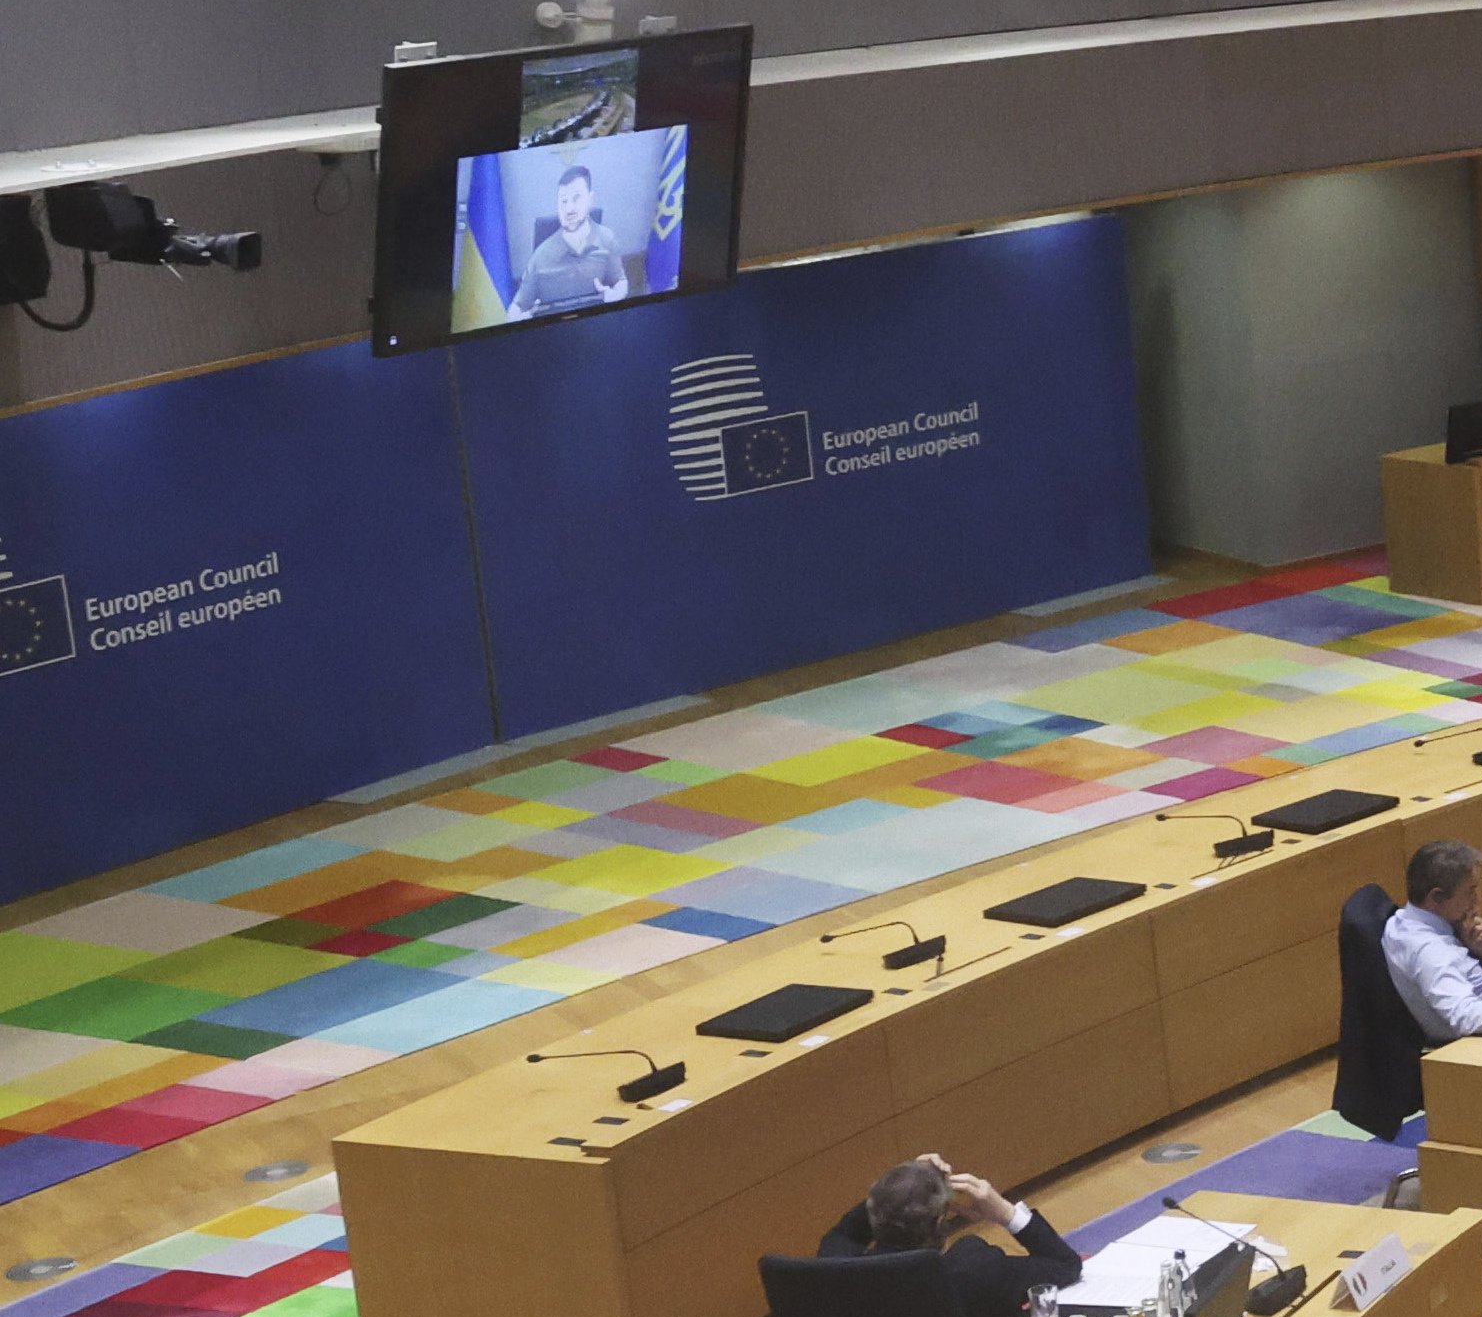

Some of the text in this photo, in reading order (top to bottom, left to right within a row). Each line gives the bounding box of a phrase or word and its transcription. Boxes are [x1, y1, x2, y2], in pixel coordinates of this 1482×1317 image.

[822, 401, 979, 450] European Council
[825, 431, 980, 476] Conseil européen
[85, 551, 280, 622] European Council
[90, 588, 282, 651] Conseil européen
